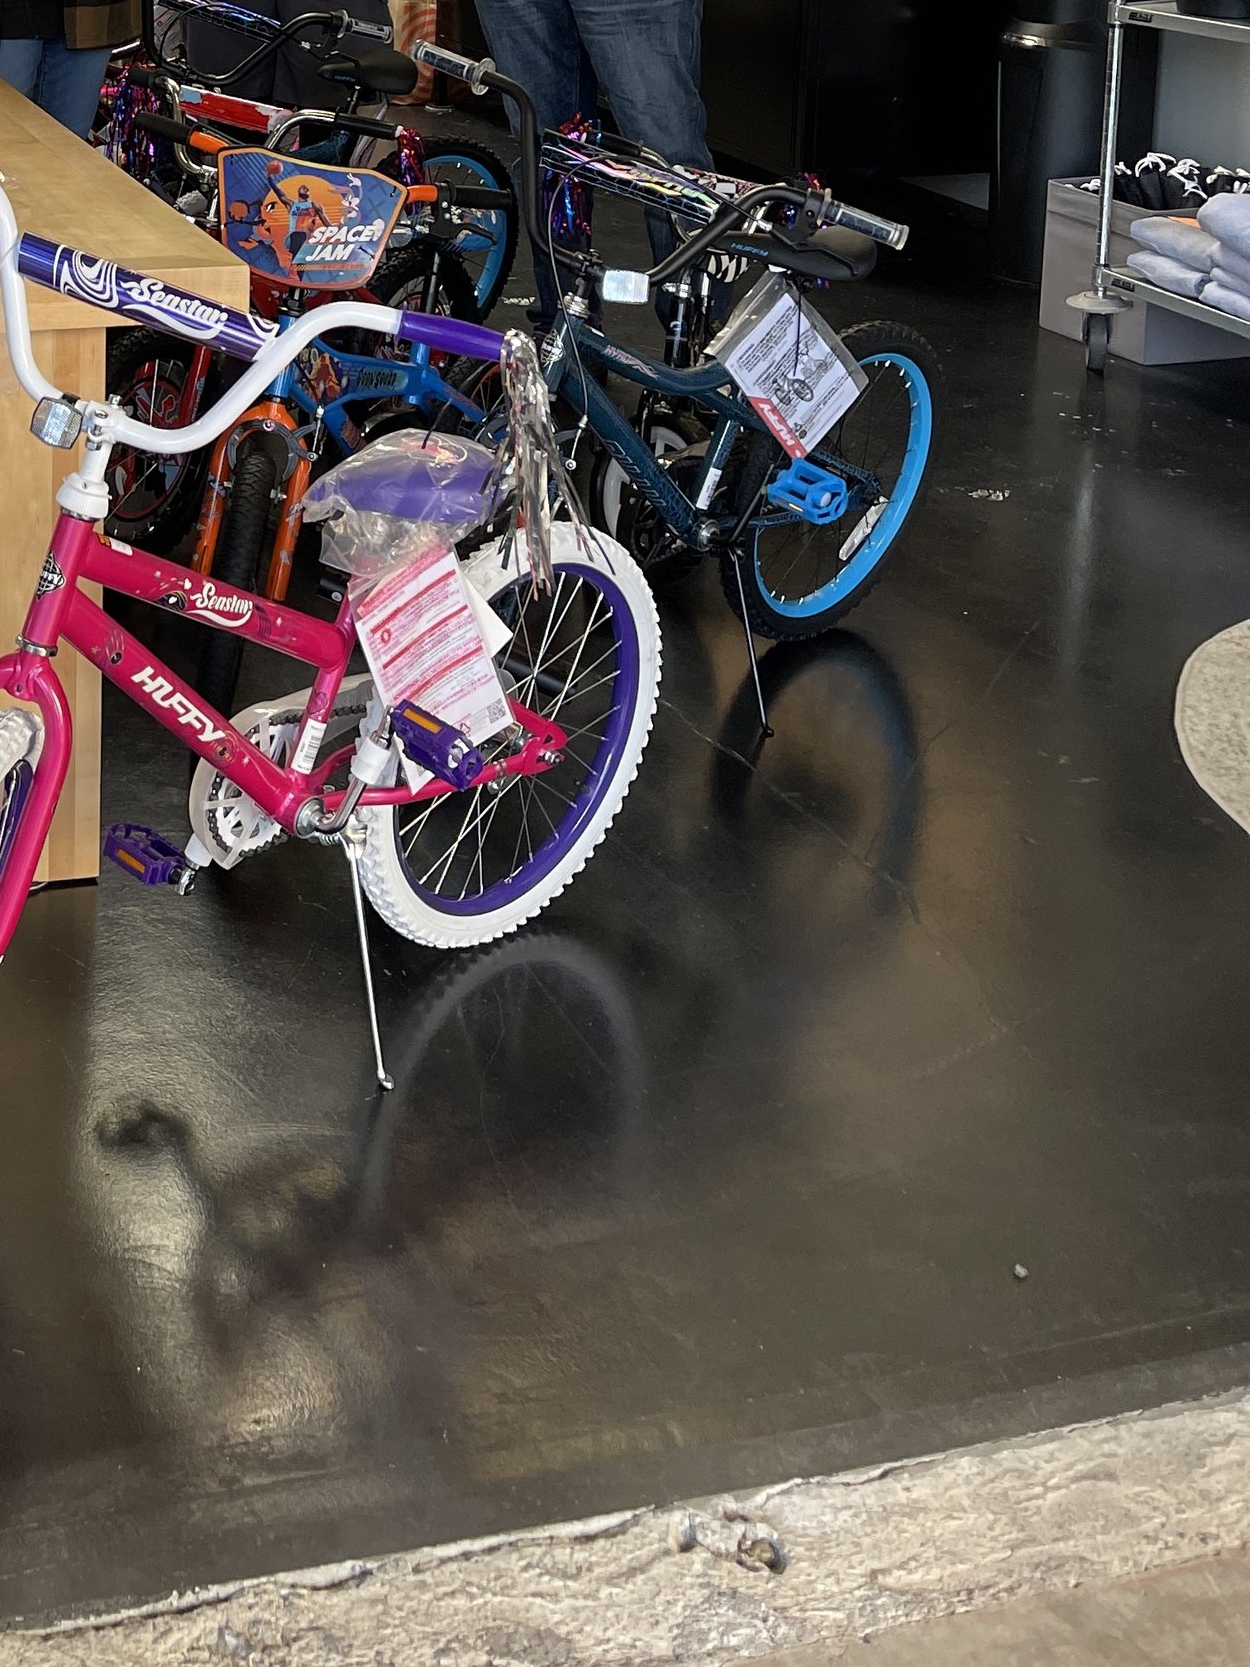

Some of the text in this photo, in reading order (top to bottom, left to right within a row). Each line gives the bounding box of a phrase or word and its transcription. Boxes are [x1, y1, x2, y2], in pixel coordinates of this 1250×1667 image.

[305, 243, 356, 262] JAM
[308, 224, 377, 244] SPACE
[120, 277, 229, 331] Seastar
[757, 402, 797, 447] HUFFY
[130, 665, 227, 743] HUFFY
